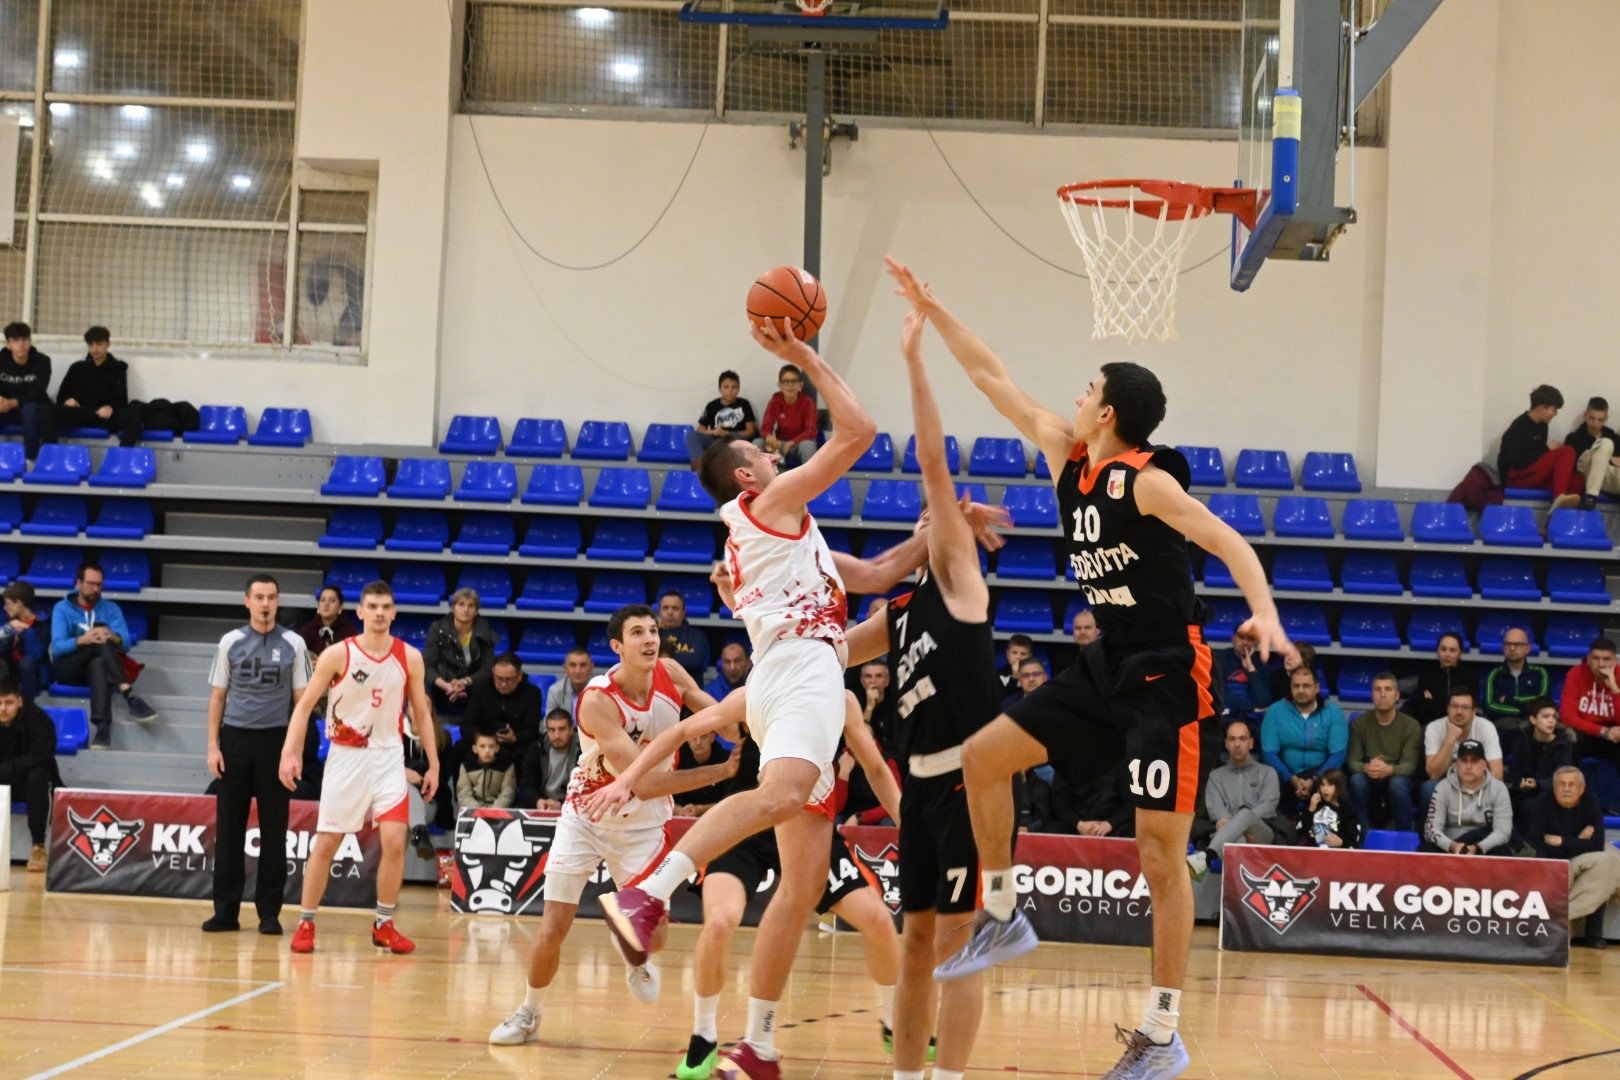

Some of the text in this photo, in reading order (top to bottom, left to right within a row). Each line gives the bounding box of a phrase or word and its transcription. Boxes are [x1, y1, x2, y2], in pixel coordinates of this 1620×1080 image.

[1072, 505, 1100, 543] 10
[896, 610, 909, 650] 7
[371, 688, 383, 708] 5
[1128, 758, 1171, 799] 10
[151, 823, 207, 854] KK
[152, 853, 215, 872] VELI
[828, 857, 859, 894] 14
[946, 866, 968, 904] 7
[1012, 864, 1152, 900] GORICA
[1329, 881, 1550, 920] KK GORICA
[1330, 912, 1549, 937] VELIKA GORICA
